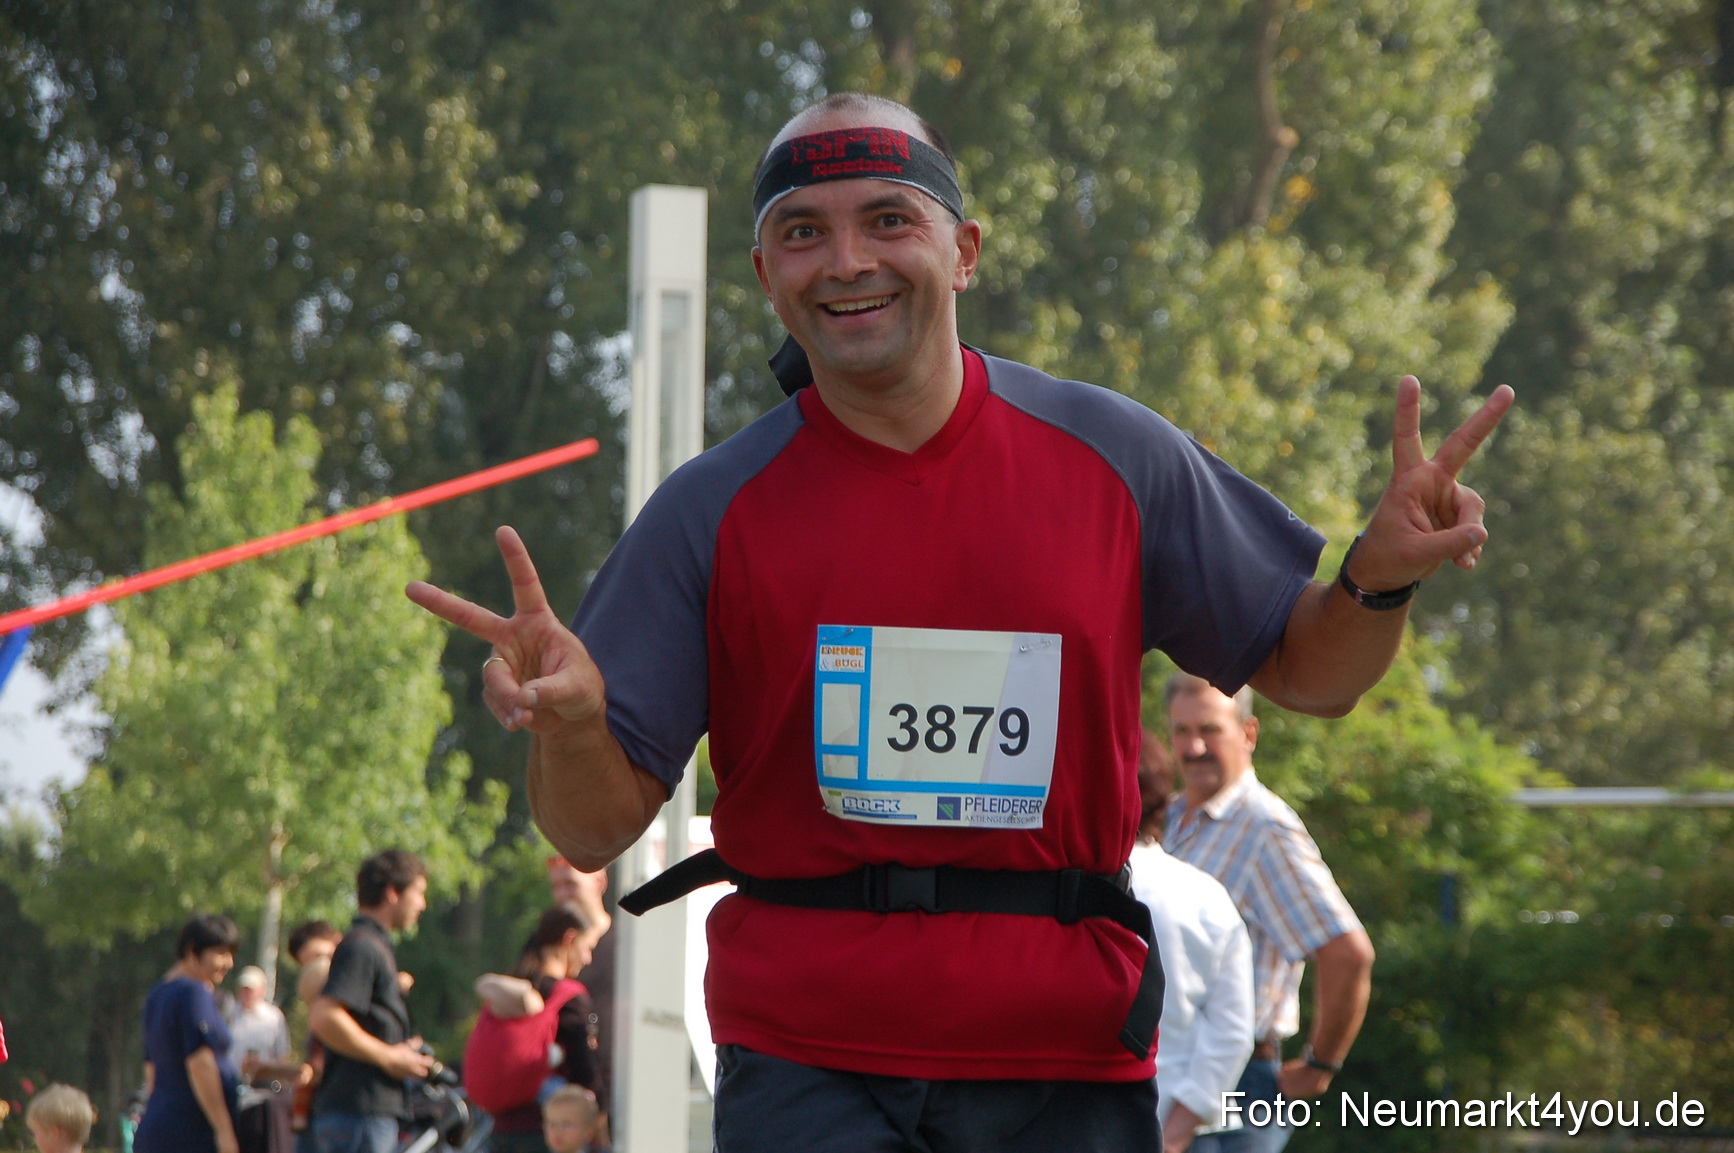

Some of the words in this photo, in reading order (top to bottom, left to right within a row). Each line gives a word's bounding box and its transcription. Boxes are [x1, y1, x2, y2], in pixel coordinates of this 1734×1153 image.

[887, 703, 1031, 756] 3879
[842, 797, 901, 812] BOCK
[965, 797, 1043, 814] PFLEIDERER
